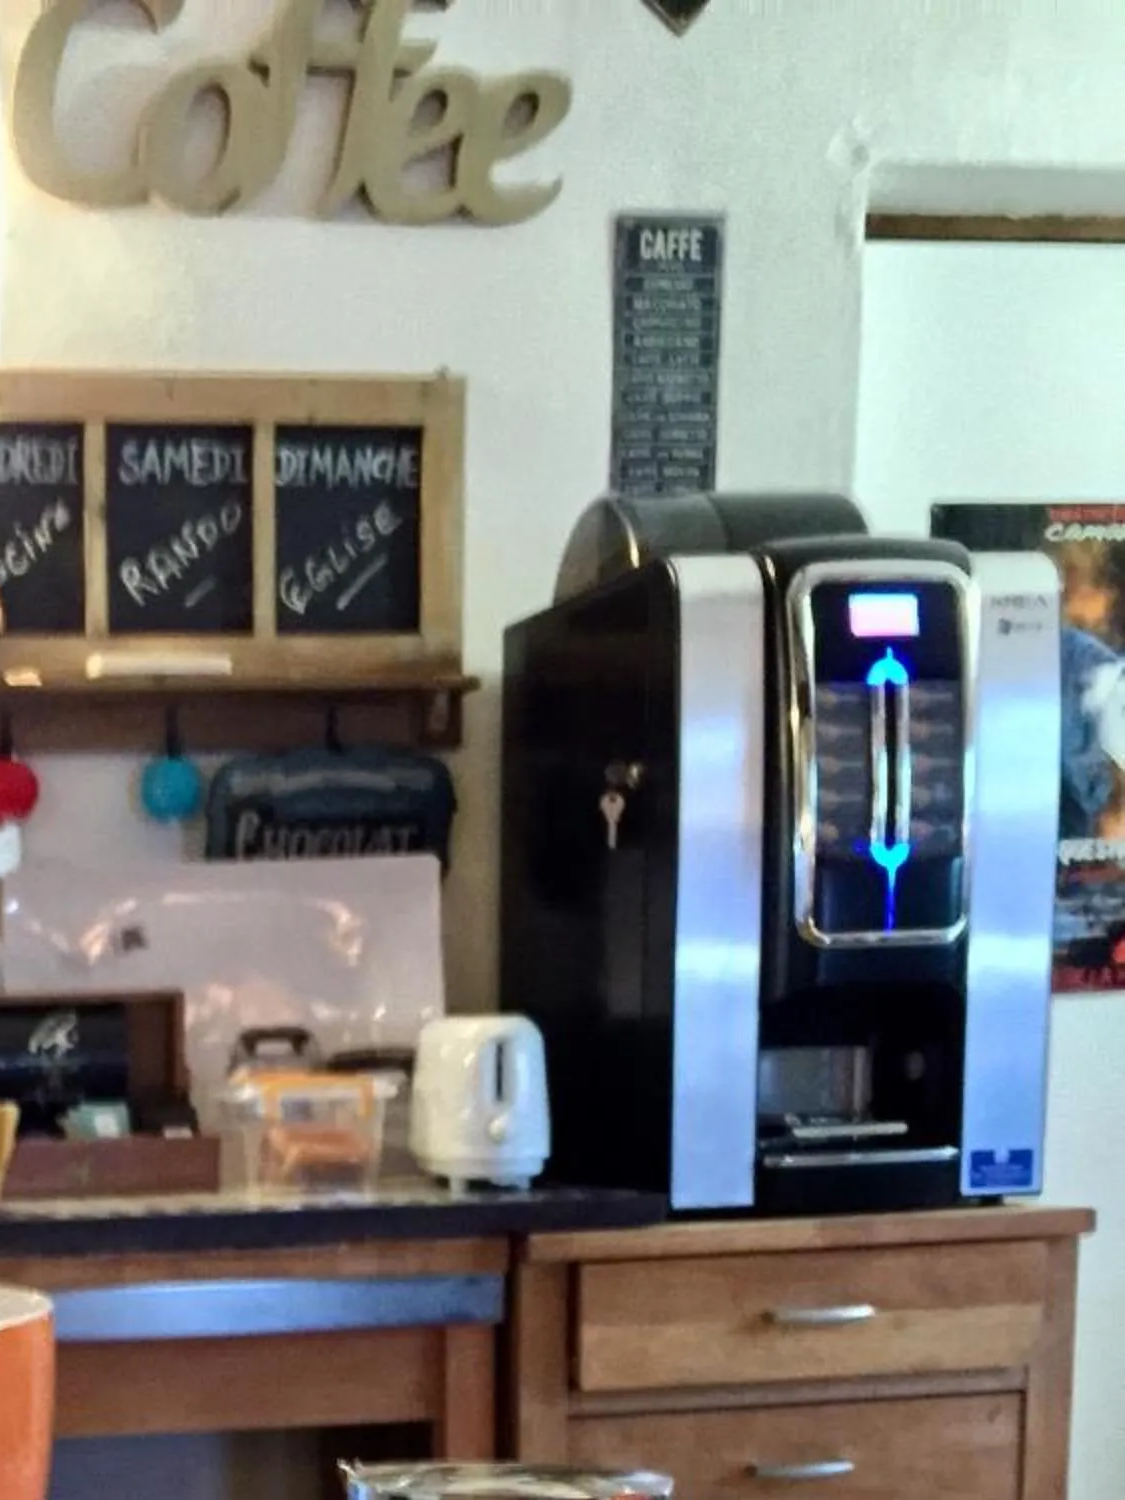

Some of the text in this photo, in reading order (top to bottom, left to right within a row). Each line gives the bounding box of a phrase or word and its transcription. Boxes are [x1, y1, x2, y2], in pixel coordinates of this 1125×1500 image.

[13, 0, 572, 226] Coffee
[117, 437, 249, 488] SAMEDI
[274, 442, 421, 490] DIMANCHE
[118, 498, 243, 608] RANDO
